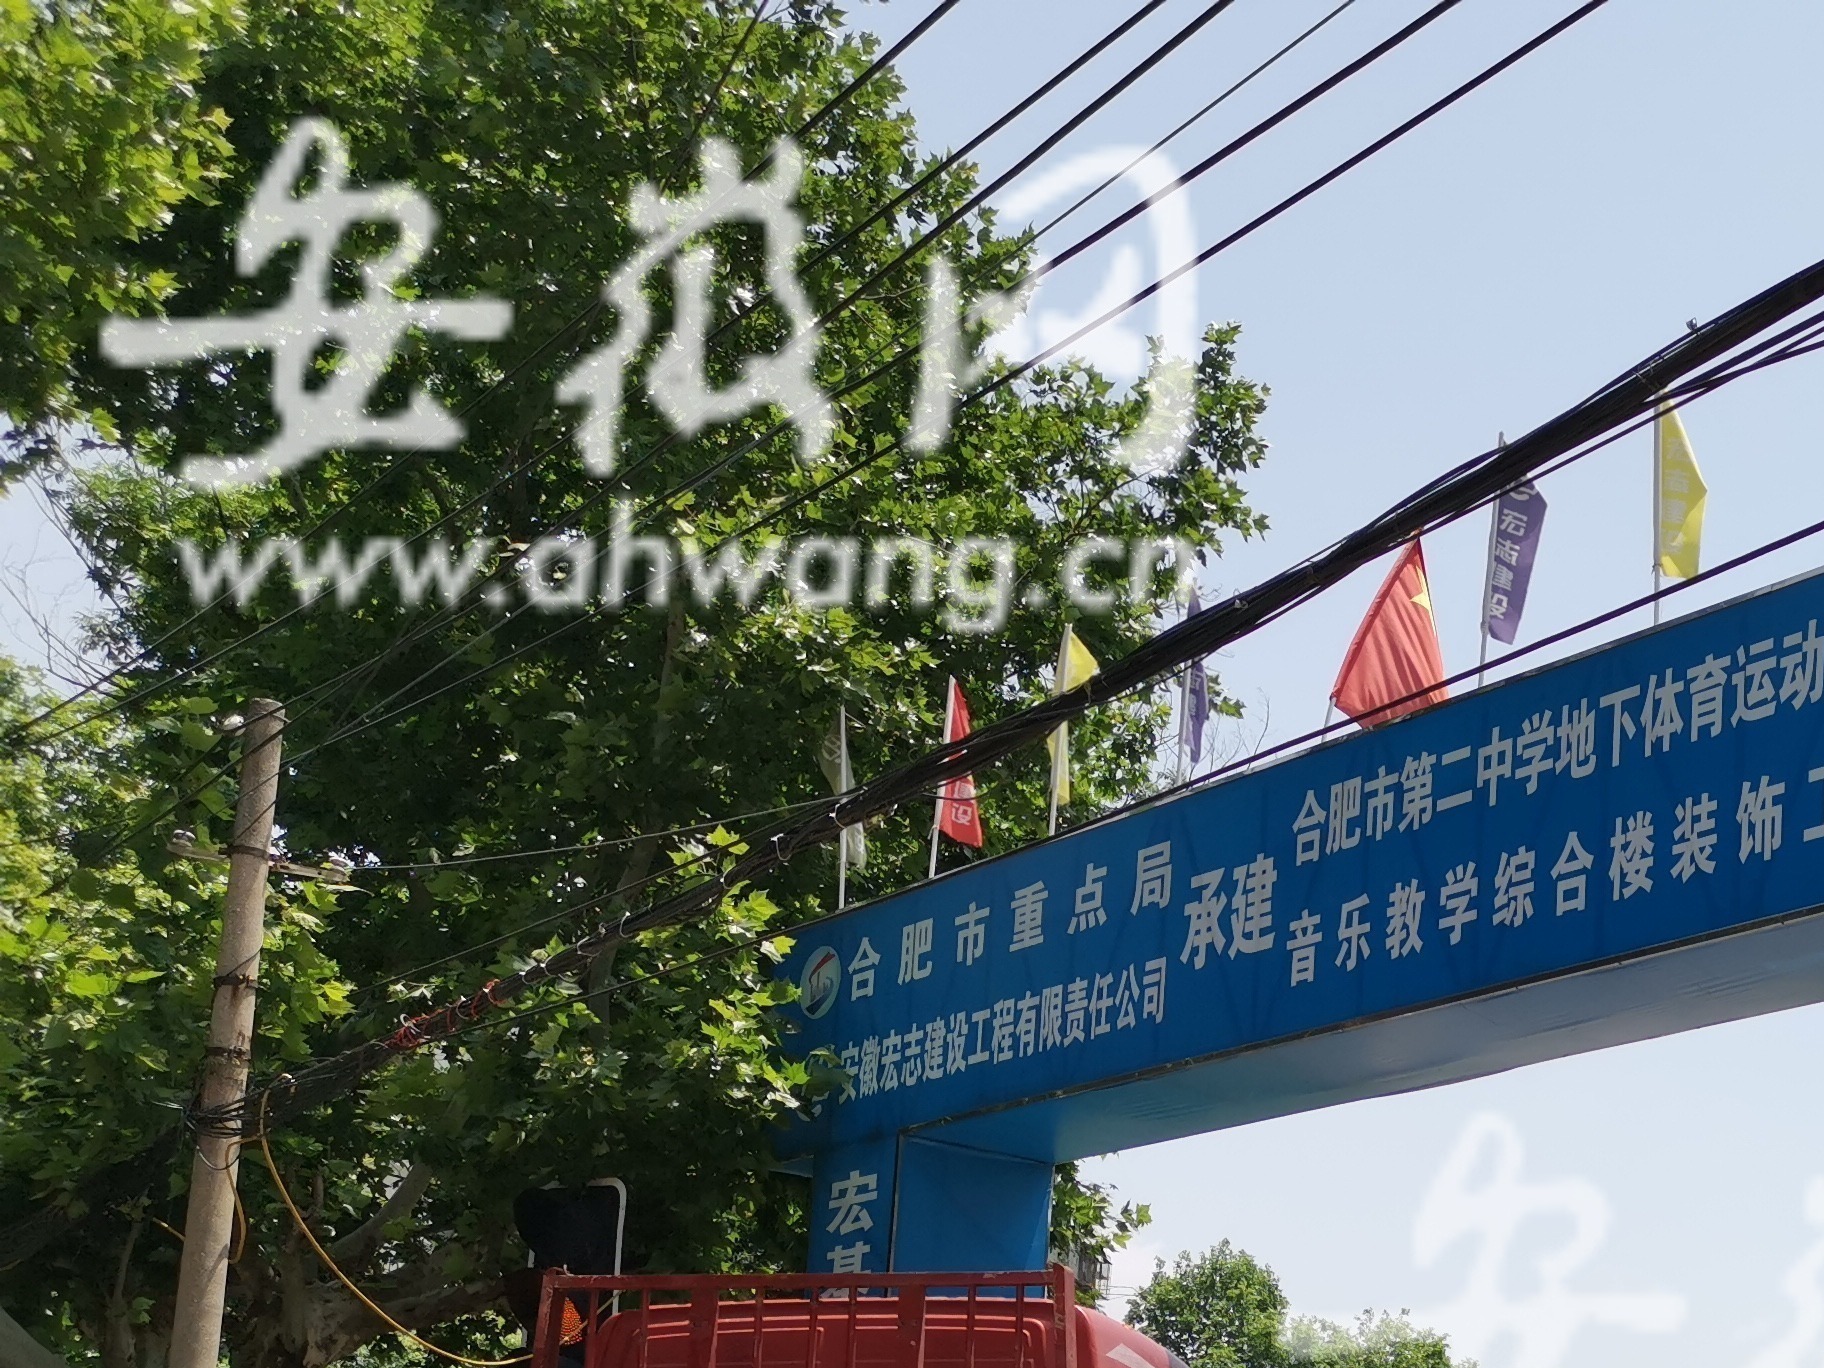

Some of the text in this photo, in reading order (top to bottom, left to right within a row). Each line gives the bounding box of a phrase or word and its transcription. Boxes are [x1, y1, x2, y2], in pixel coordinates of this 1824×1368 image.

[849, 842, 1171, 1001] 合肥市重点局
[1180, 854, 1277, 970] 承建
[838, 958, 1167, 1105] 安徽宏志建设工程有限责任公司
